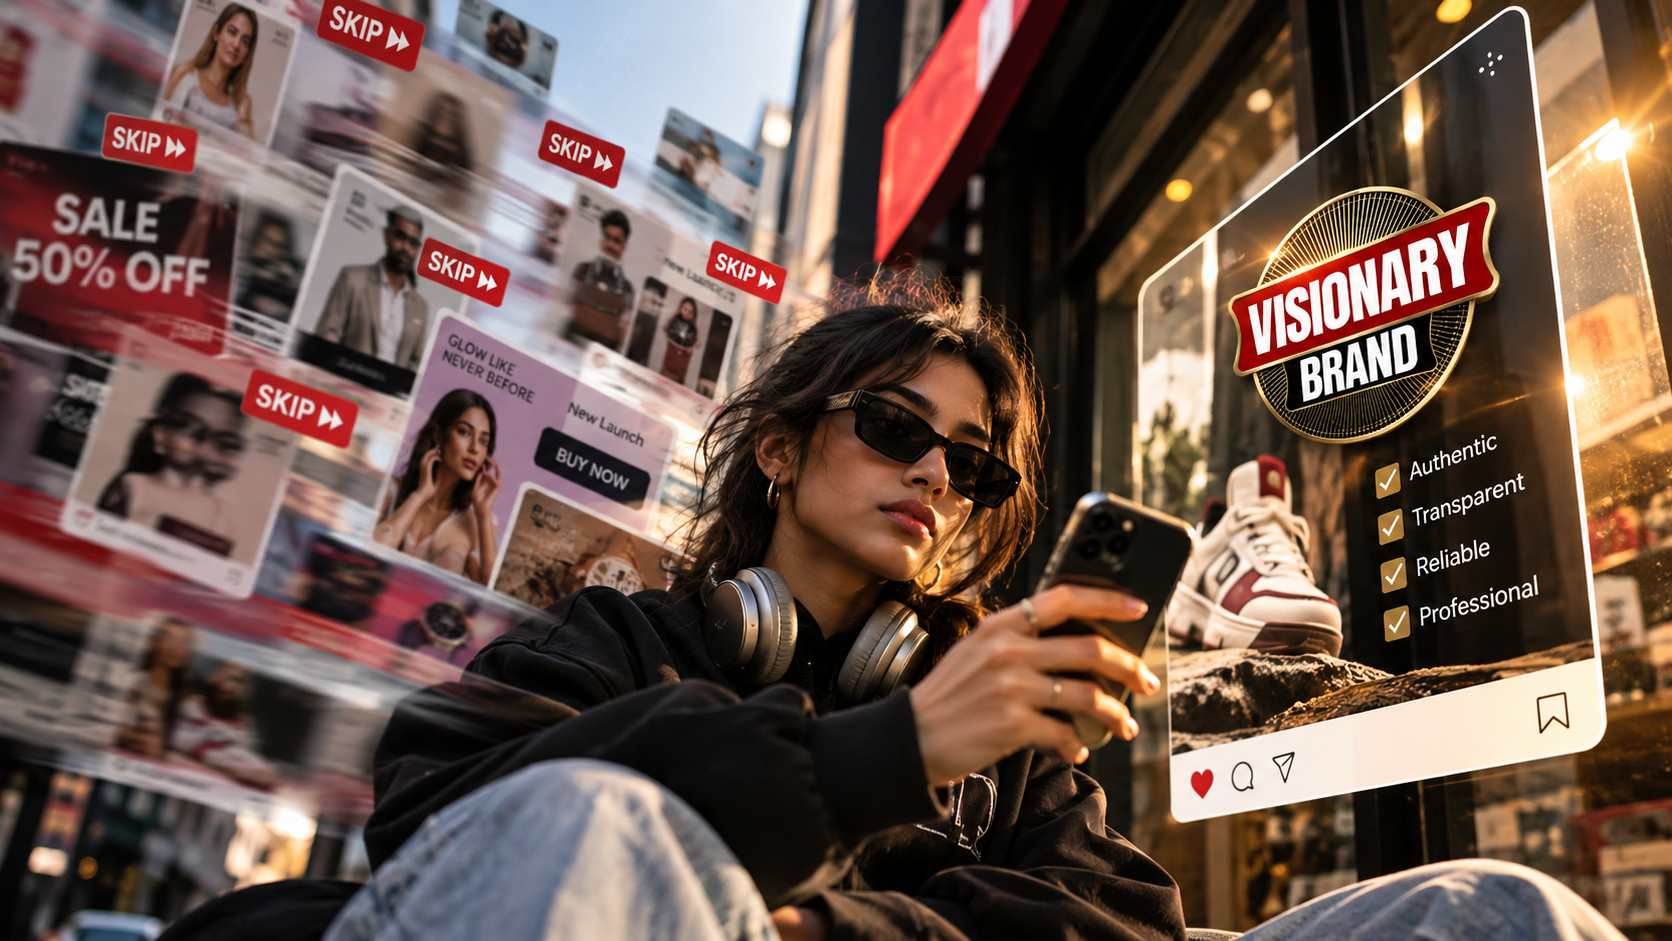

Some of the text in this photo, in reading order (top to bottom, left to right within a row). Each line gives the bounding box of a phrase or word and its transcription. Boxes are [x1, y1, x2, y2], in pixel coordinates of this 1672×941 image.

[330, 6, 384, 43] SKIP
[112, 126, 161, 155] SKIP
[548, 133, 592, 164] SKIP
[53, 194, 160, 243] SALE
[11, 239, 211, 297] 50% OFF
[428, 250, 476, 283] SKIP
[714, 252, 757, 282] SKIP
[1248, 222, 1470, 356] VISIONARY
[441, 349, 536, 404] NEVER BEFORE
[448, 333, 517, 377] GLOW LIKE
[1300, 324, 1418, 403] BRAND
[255, 384, 316, 420] SKIP
[567, 401, 645, 448] New Launch
[556, 447, 630, 491] BUY NOW
[1409, 434, 1498, 481] Authentic
[1411, 472, 1526, 527] Transparent
[1416, 539, 1490, 577] Reliable
[1419, 574, 1539, 627] Professional
